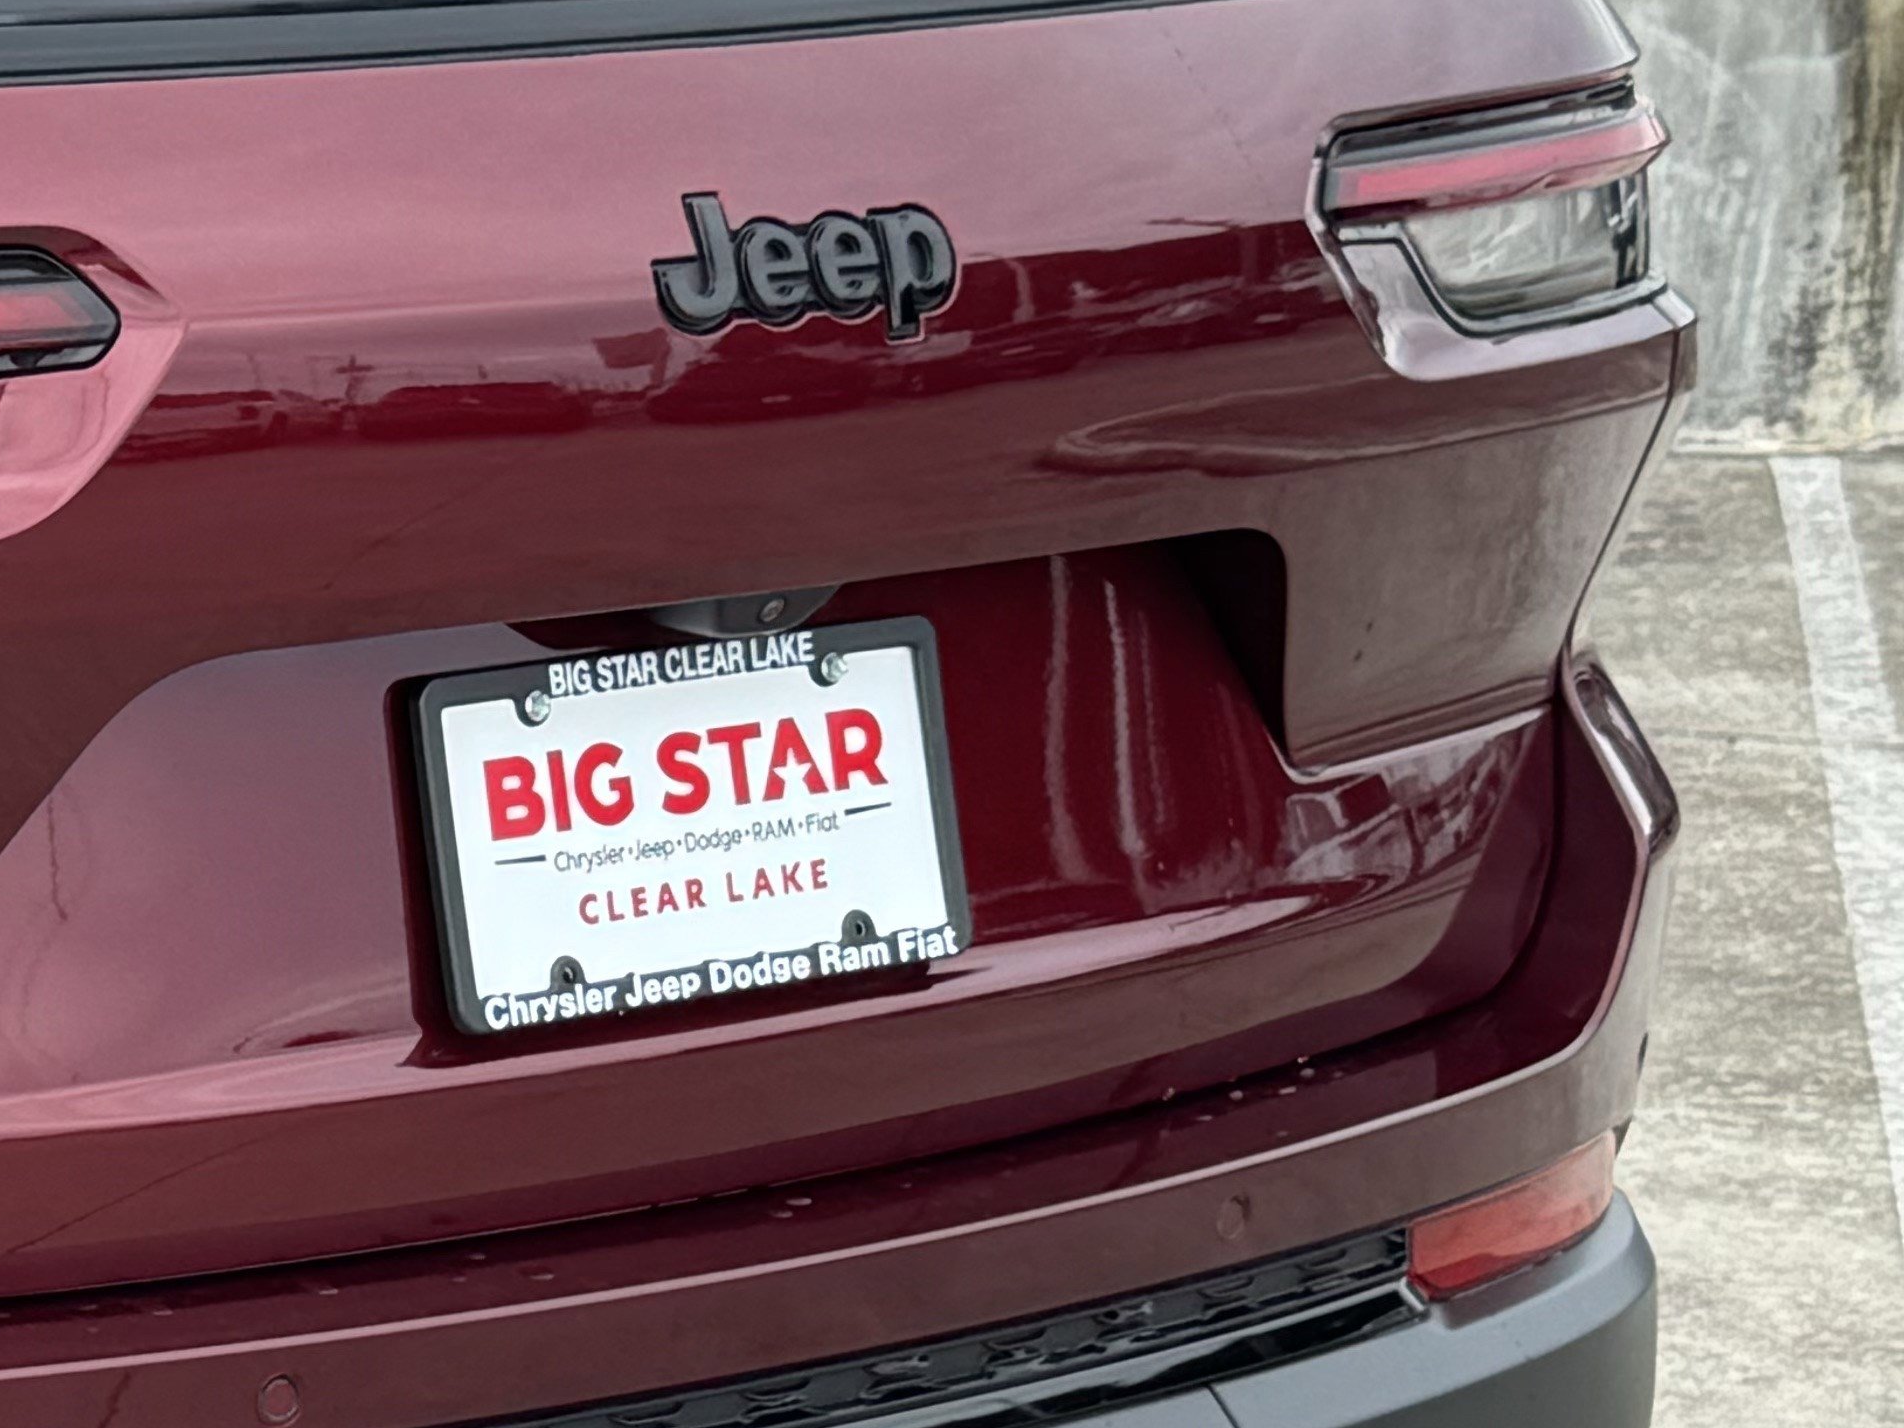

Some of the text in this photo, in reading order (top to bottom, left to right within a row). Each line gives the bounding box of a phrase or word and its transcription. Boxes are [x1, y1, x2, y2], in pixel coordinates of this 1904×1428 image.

[650, 190, 957, 342] Jeep
[548, 630, 816, 696] BIG STAR CLEAR LAKE
[482, 707, 889, 842] BIG STAR
[578, 858, 829, 926] CLEAR LAKE
[484, 925, 958, 1031] Chrysler Jeep Dodge Ram Fiat
